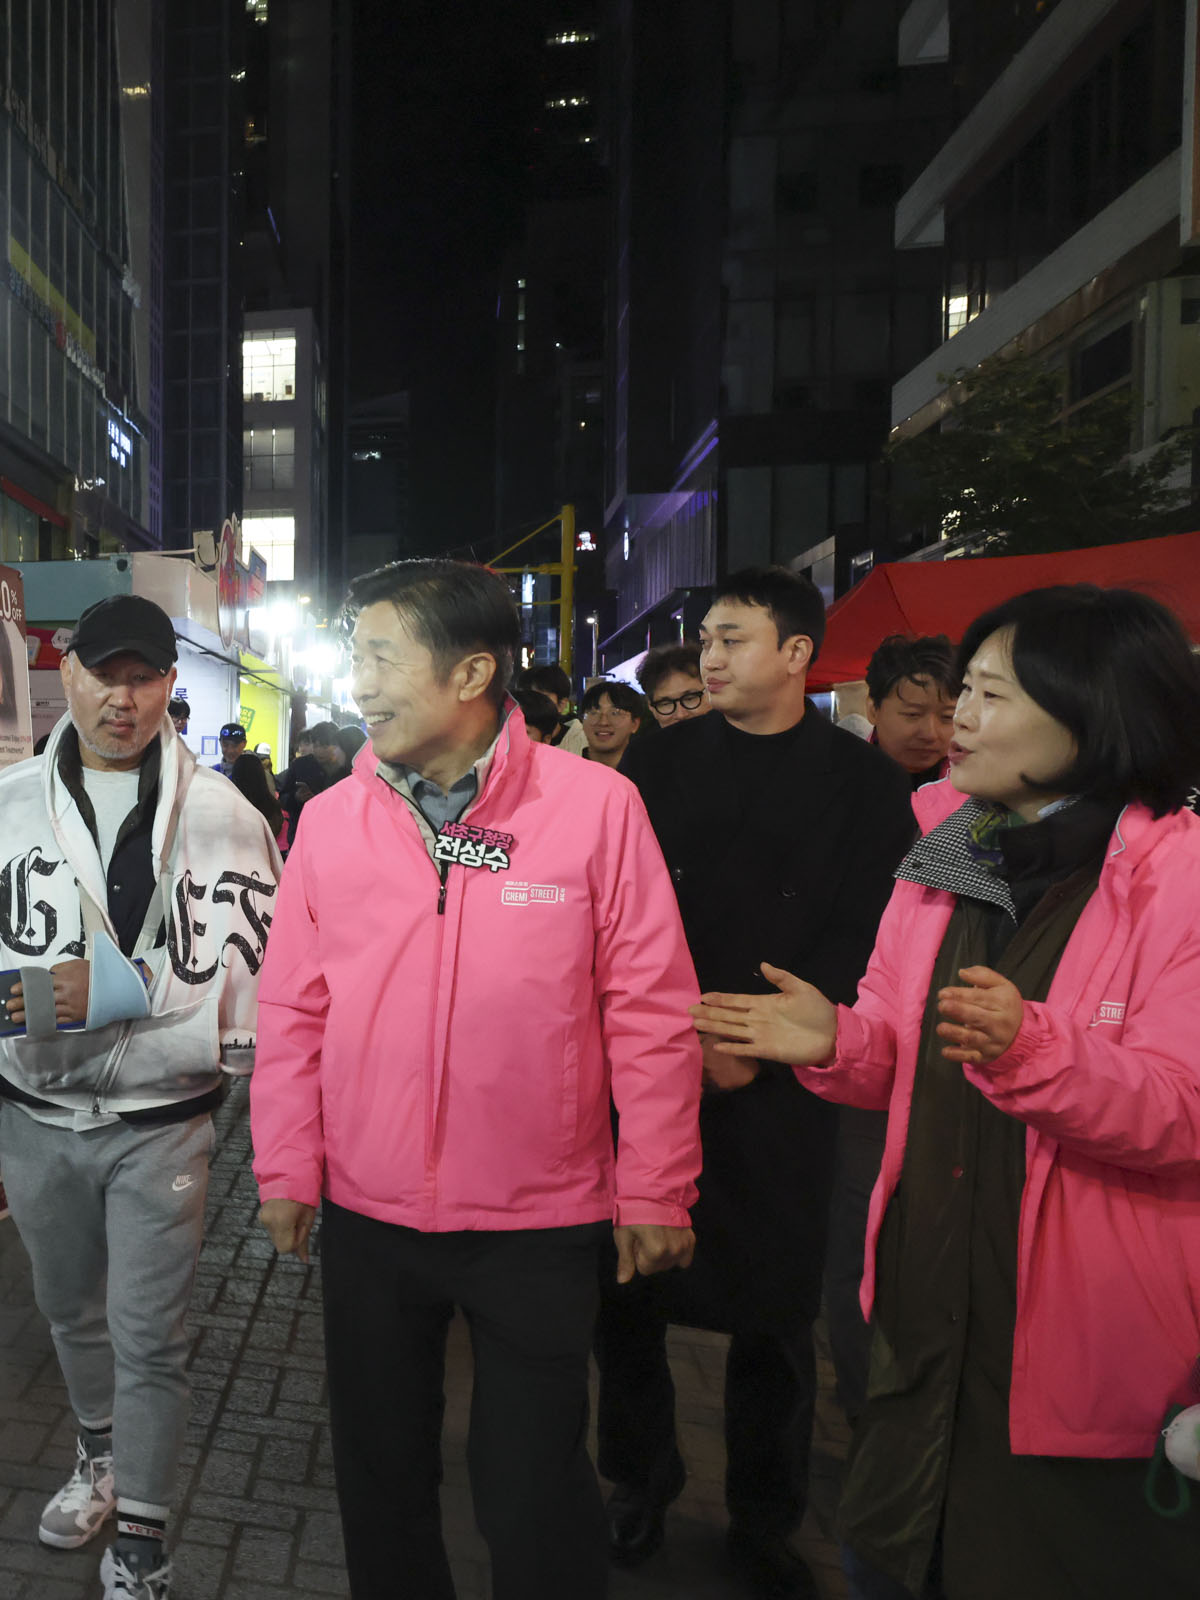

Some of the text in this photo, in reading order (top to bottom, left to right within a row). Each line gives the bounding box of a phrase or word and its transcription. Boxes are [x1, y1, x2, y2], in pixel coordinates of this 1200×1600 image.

[440, 821, 513, 850] 서초구청장
[434, 834, 510, 872] 전성수
[505, 891, 528, 902] CHEMI
[530, 888, 554, 899] STREET
[175, 1174, 191, 1185] NIKE
